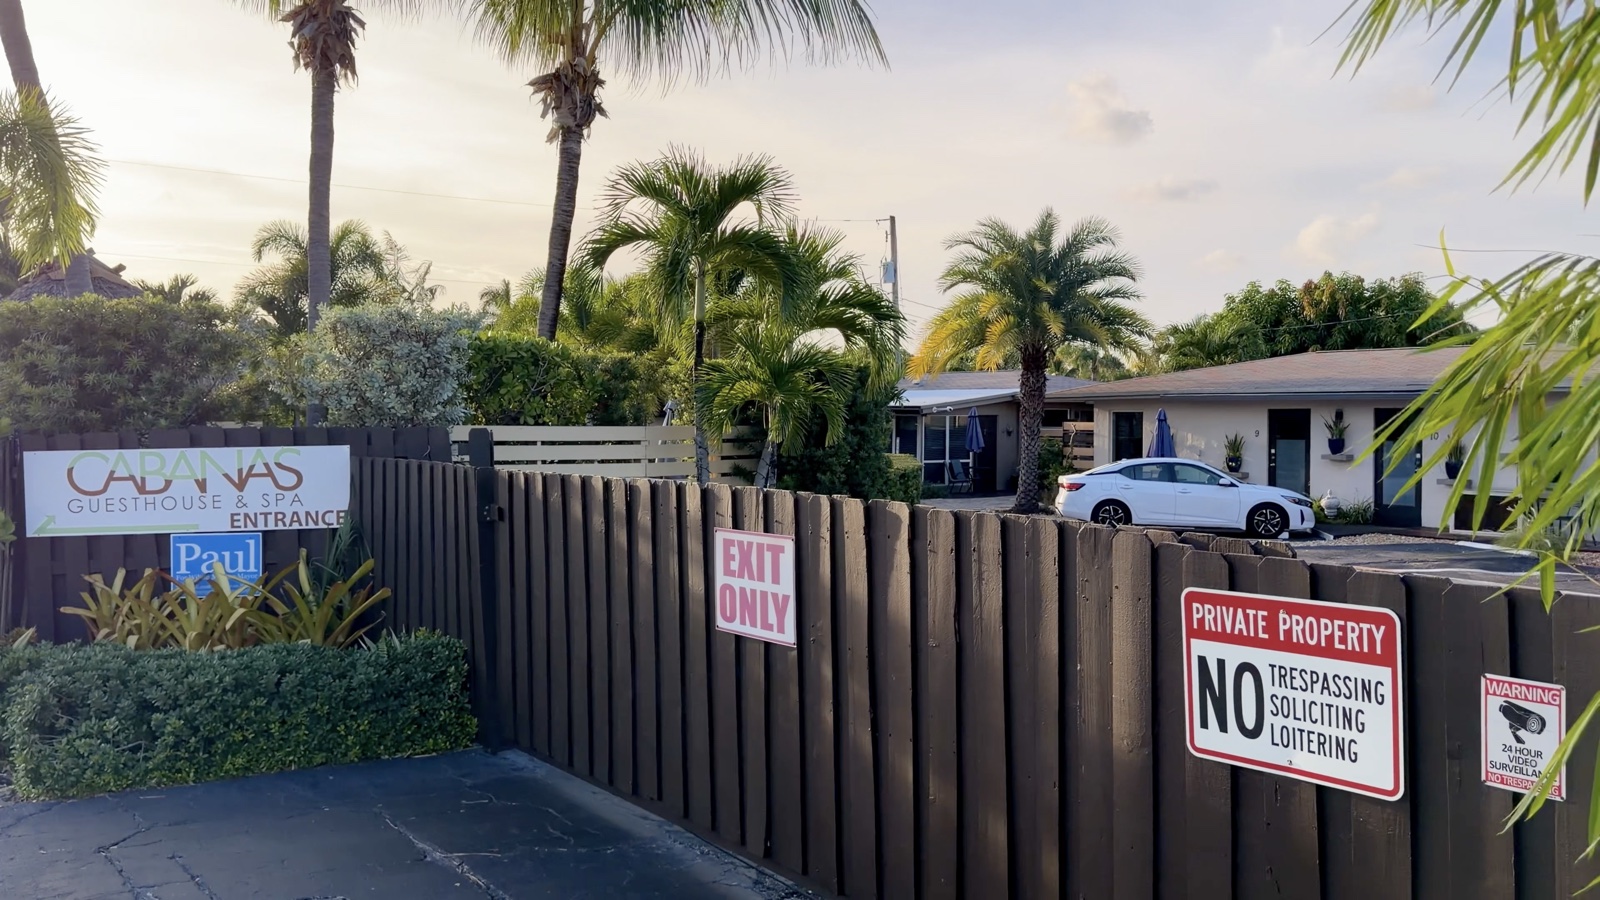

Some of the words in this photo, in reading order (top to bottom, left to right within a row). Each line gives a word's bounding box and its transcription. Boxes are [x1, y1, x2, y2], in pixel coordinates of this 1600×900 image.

[1254, 429, 1260, 437] 9
[66, 448, 304, 496] CABANAS
[67, 494, 222, 513] GUESTHOUSE
[235, 495, 248, 508] &
[261, 493, 304, 507] SPA
[230, 509, 348, 529] ENTRANCE
[176, 539, 258, 574] Paul
[723, 538, 785, 585] EXIT
[720, 583, 791, 635] ONLY
[1192, 602, 1269, 639] PRIVATE
[1278, 612, 1386, 654] PROPERTY
[1197, 655, 1265, 740] NO
[1269, 663, 1385, 705] TRESPASSING
[1487, 680, 1560, 704] WARNING
[1270, 694, 1366, 734] SOLICITING
[1270, 723, 1358, 763] LOITERING
[1501, 744, 1513, 754] 24
[1515, 746, 1543, 759] HOUR
[1507, 754, 1538, 767] VIDEO
[1488, 772, 1501, 783] NO
[1503, 775, 1559, 796] TRESPAG
[1489, 760, 1545, 779] SURVEILLAN
